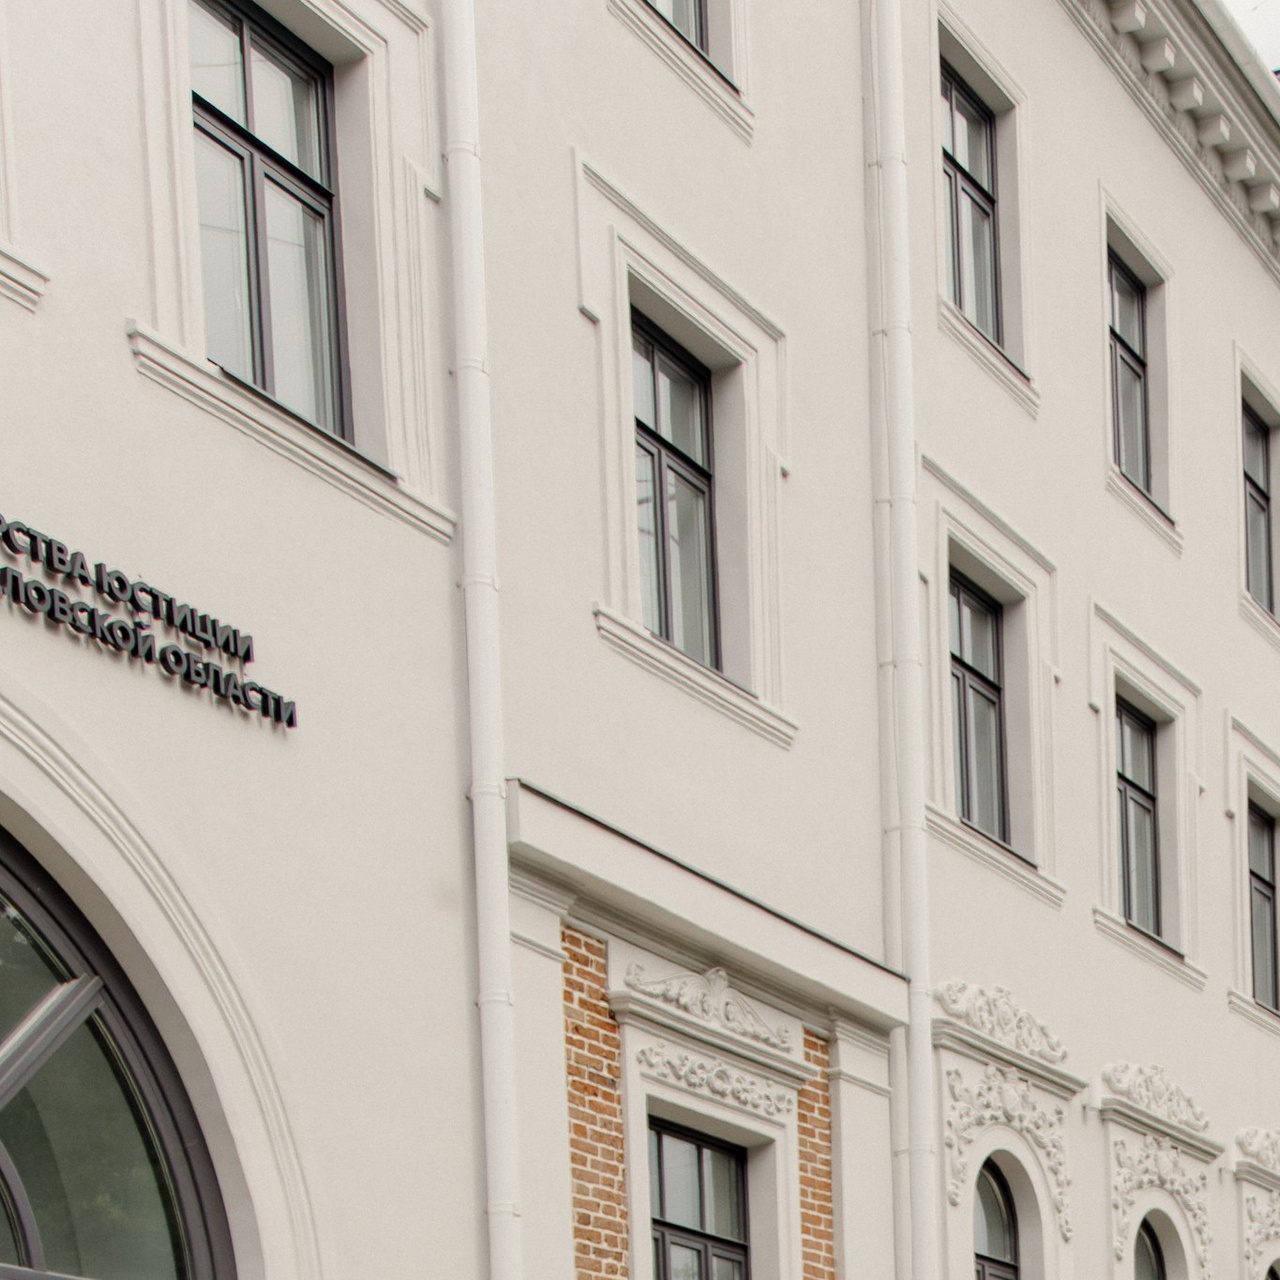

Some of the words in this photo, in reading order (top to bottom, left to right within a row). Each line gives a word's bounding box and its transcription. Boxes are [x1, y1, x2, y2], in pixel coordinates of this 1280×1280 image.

[0, 566, 157, 664] ЛОВСКОЙ
[160, 644, 298, 728] ОБЛАСТИ
[94, 563, 255, 663] ЮСТИЦИИ
